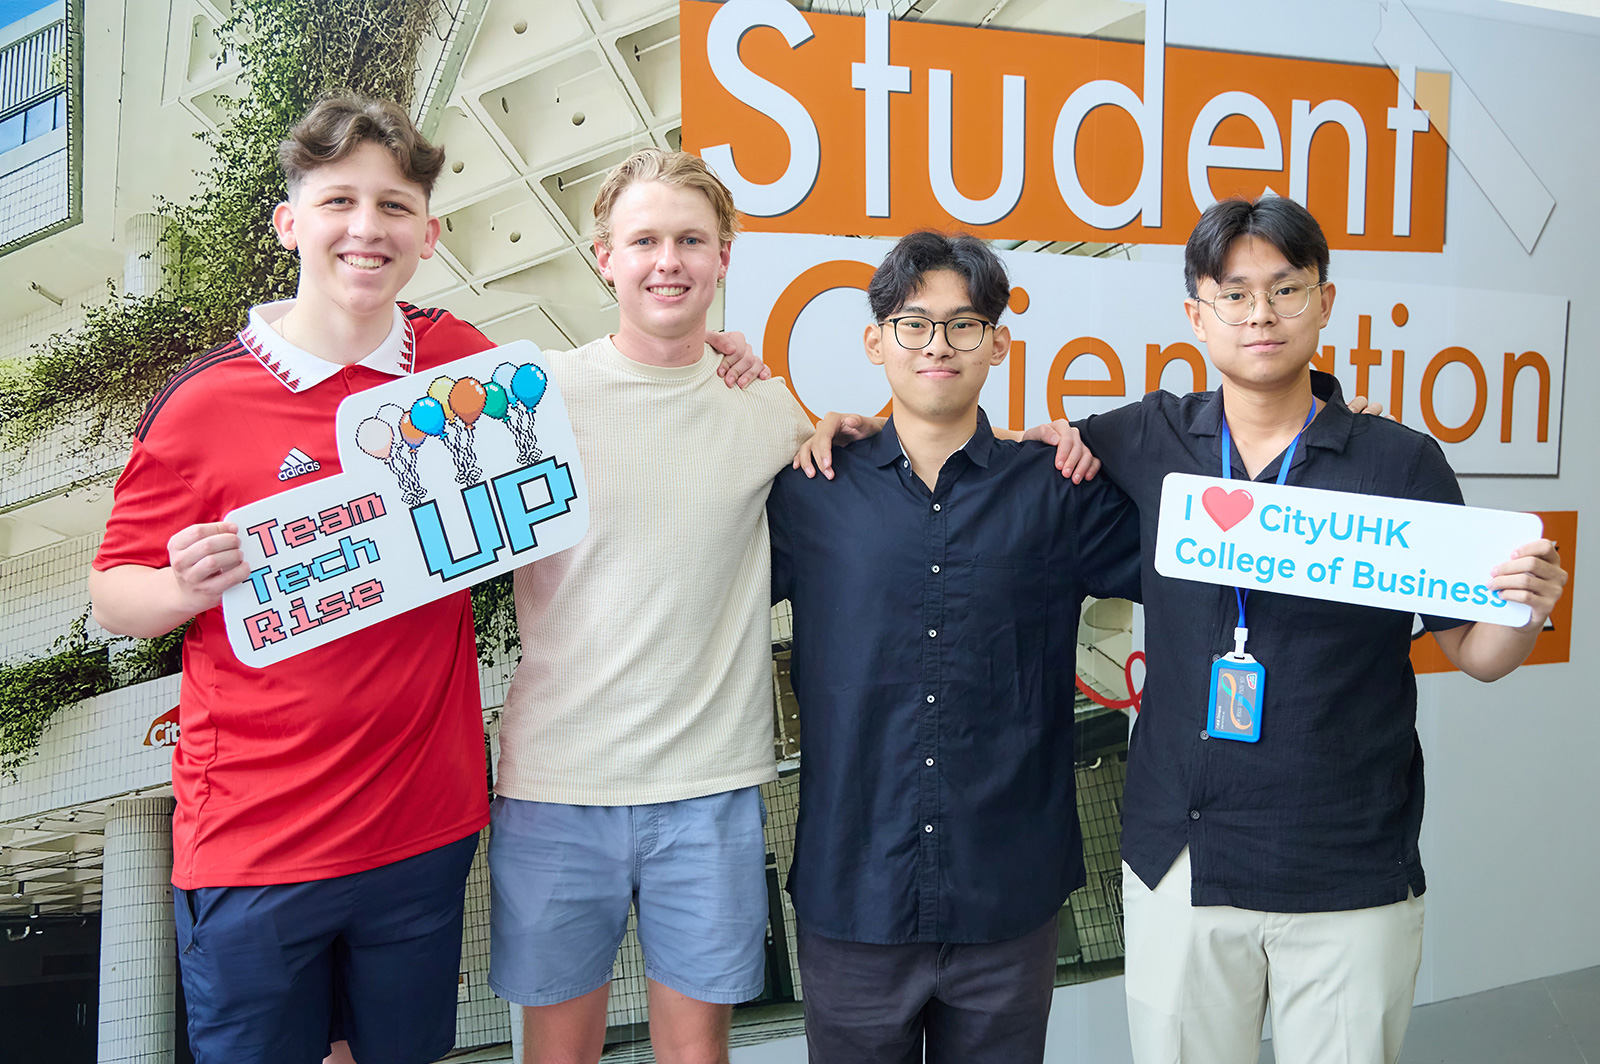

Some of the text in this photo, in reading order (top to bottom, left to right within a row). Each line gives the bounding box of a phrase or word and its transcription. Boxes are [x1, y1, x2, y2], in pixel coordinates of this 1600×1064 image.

[700, 0, 1430, 238] Student
[762, 259, 1551, 443] Oiention
[277, 461, 321, 482] adidas
[247, 493, 387, 558] Team
[409, 456, 578, 582] UP
[1184, 494, 1412, 549] I CityUHK
[243, 536, 381, 605] Tech
[1175, 537, 1297, 584] College
[1306, 556, 1345, 585] of
[1352, 560, 1508, 608] Business
[243, 578, 385, 651] Rise
[150, 721, 181, 747] Cit
